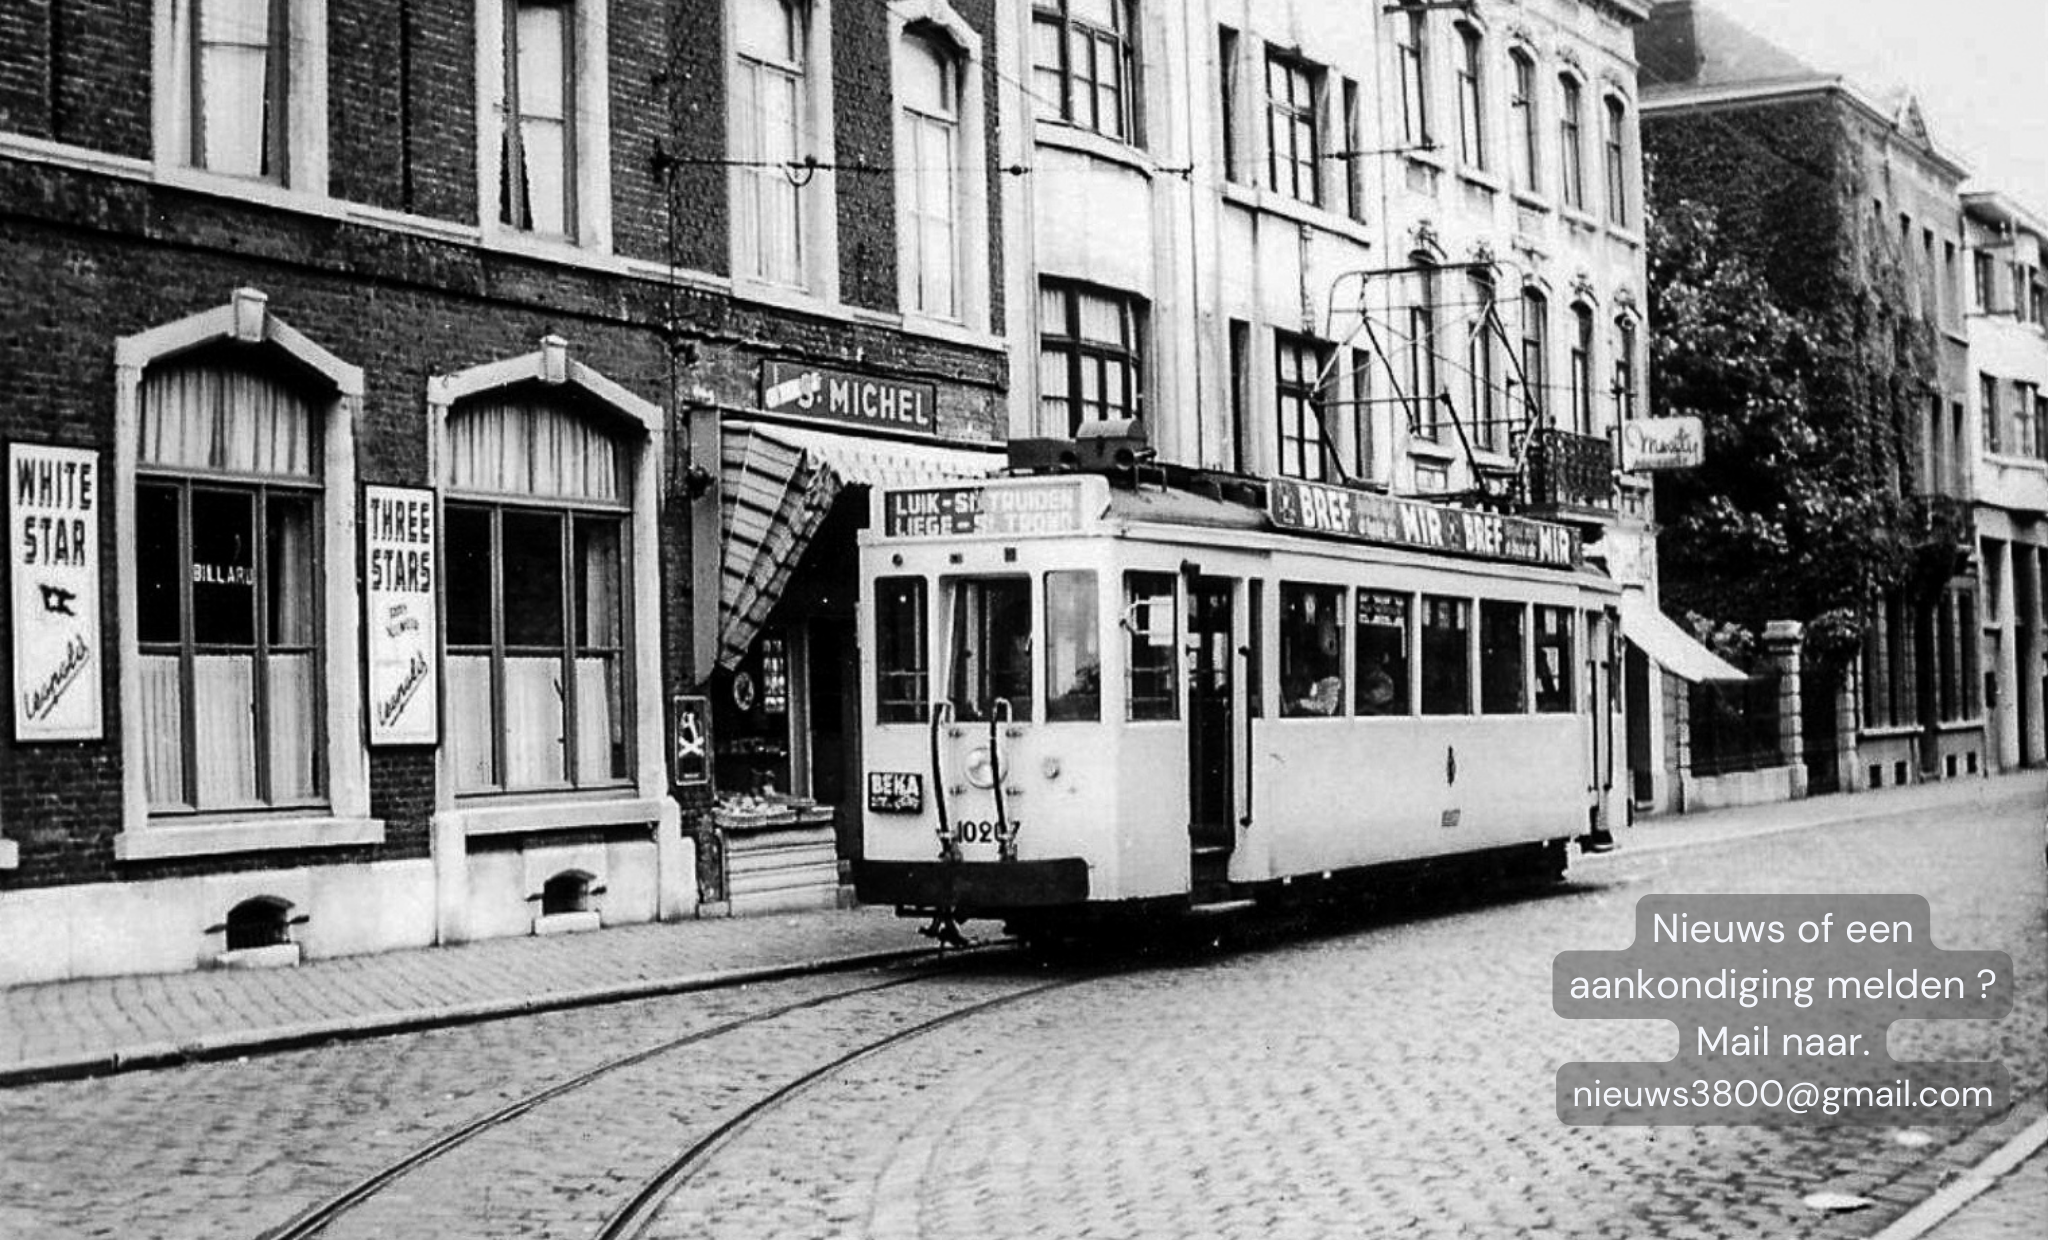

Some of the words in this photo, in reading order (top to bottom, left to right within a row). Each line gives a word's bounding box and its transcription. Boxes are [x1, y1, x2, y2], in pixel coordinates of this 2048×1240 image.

[829, 377, 929, 426] MICHEL
[17, 458, 92, 510] WHITE
[23, 516, 85, 566] STAR
[371, 498, 430, 543] THREE
[1298, 485, 1351, 532] BREF
[1399, 503, 1444, 547] MIR
[1462, 513, 1502, 556] BREF
[1539, 525, 1570, 564] MIR
[371, 549, 430, 592] STARS
[871, 774, 920, 796] BEKA
